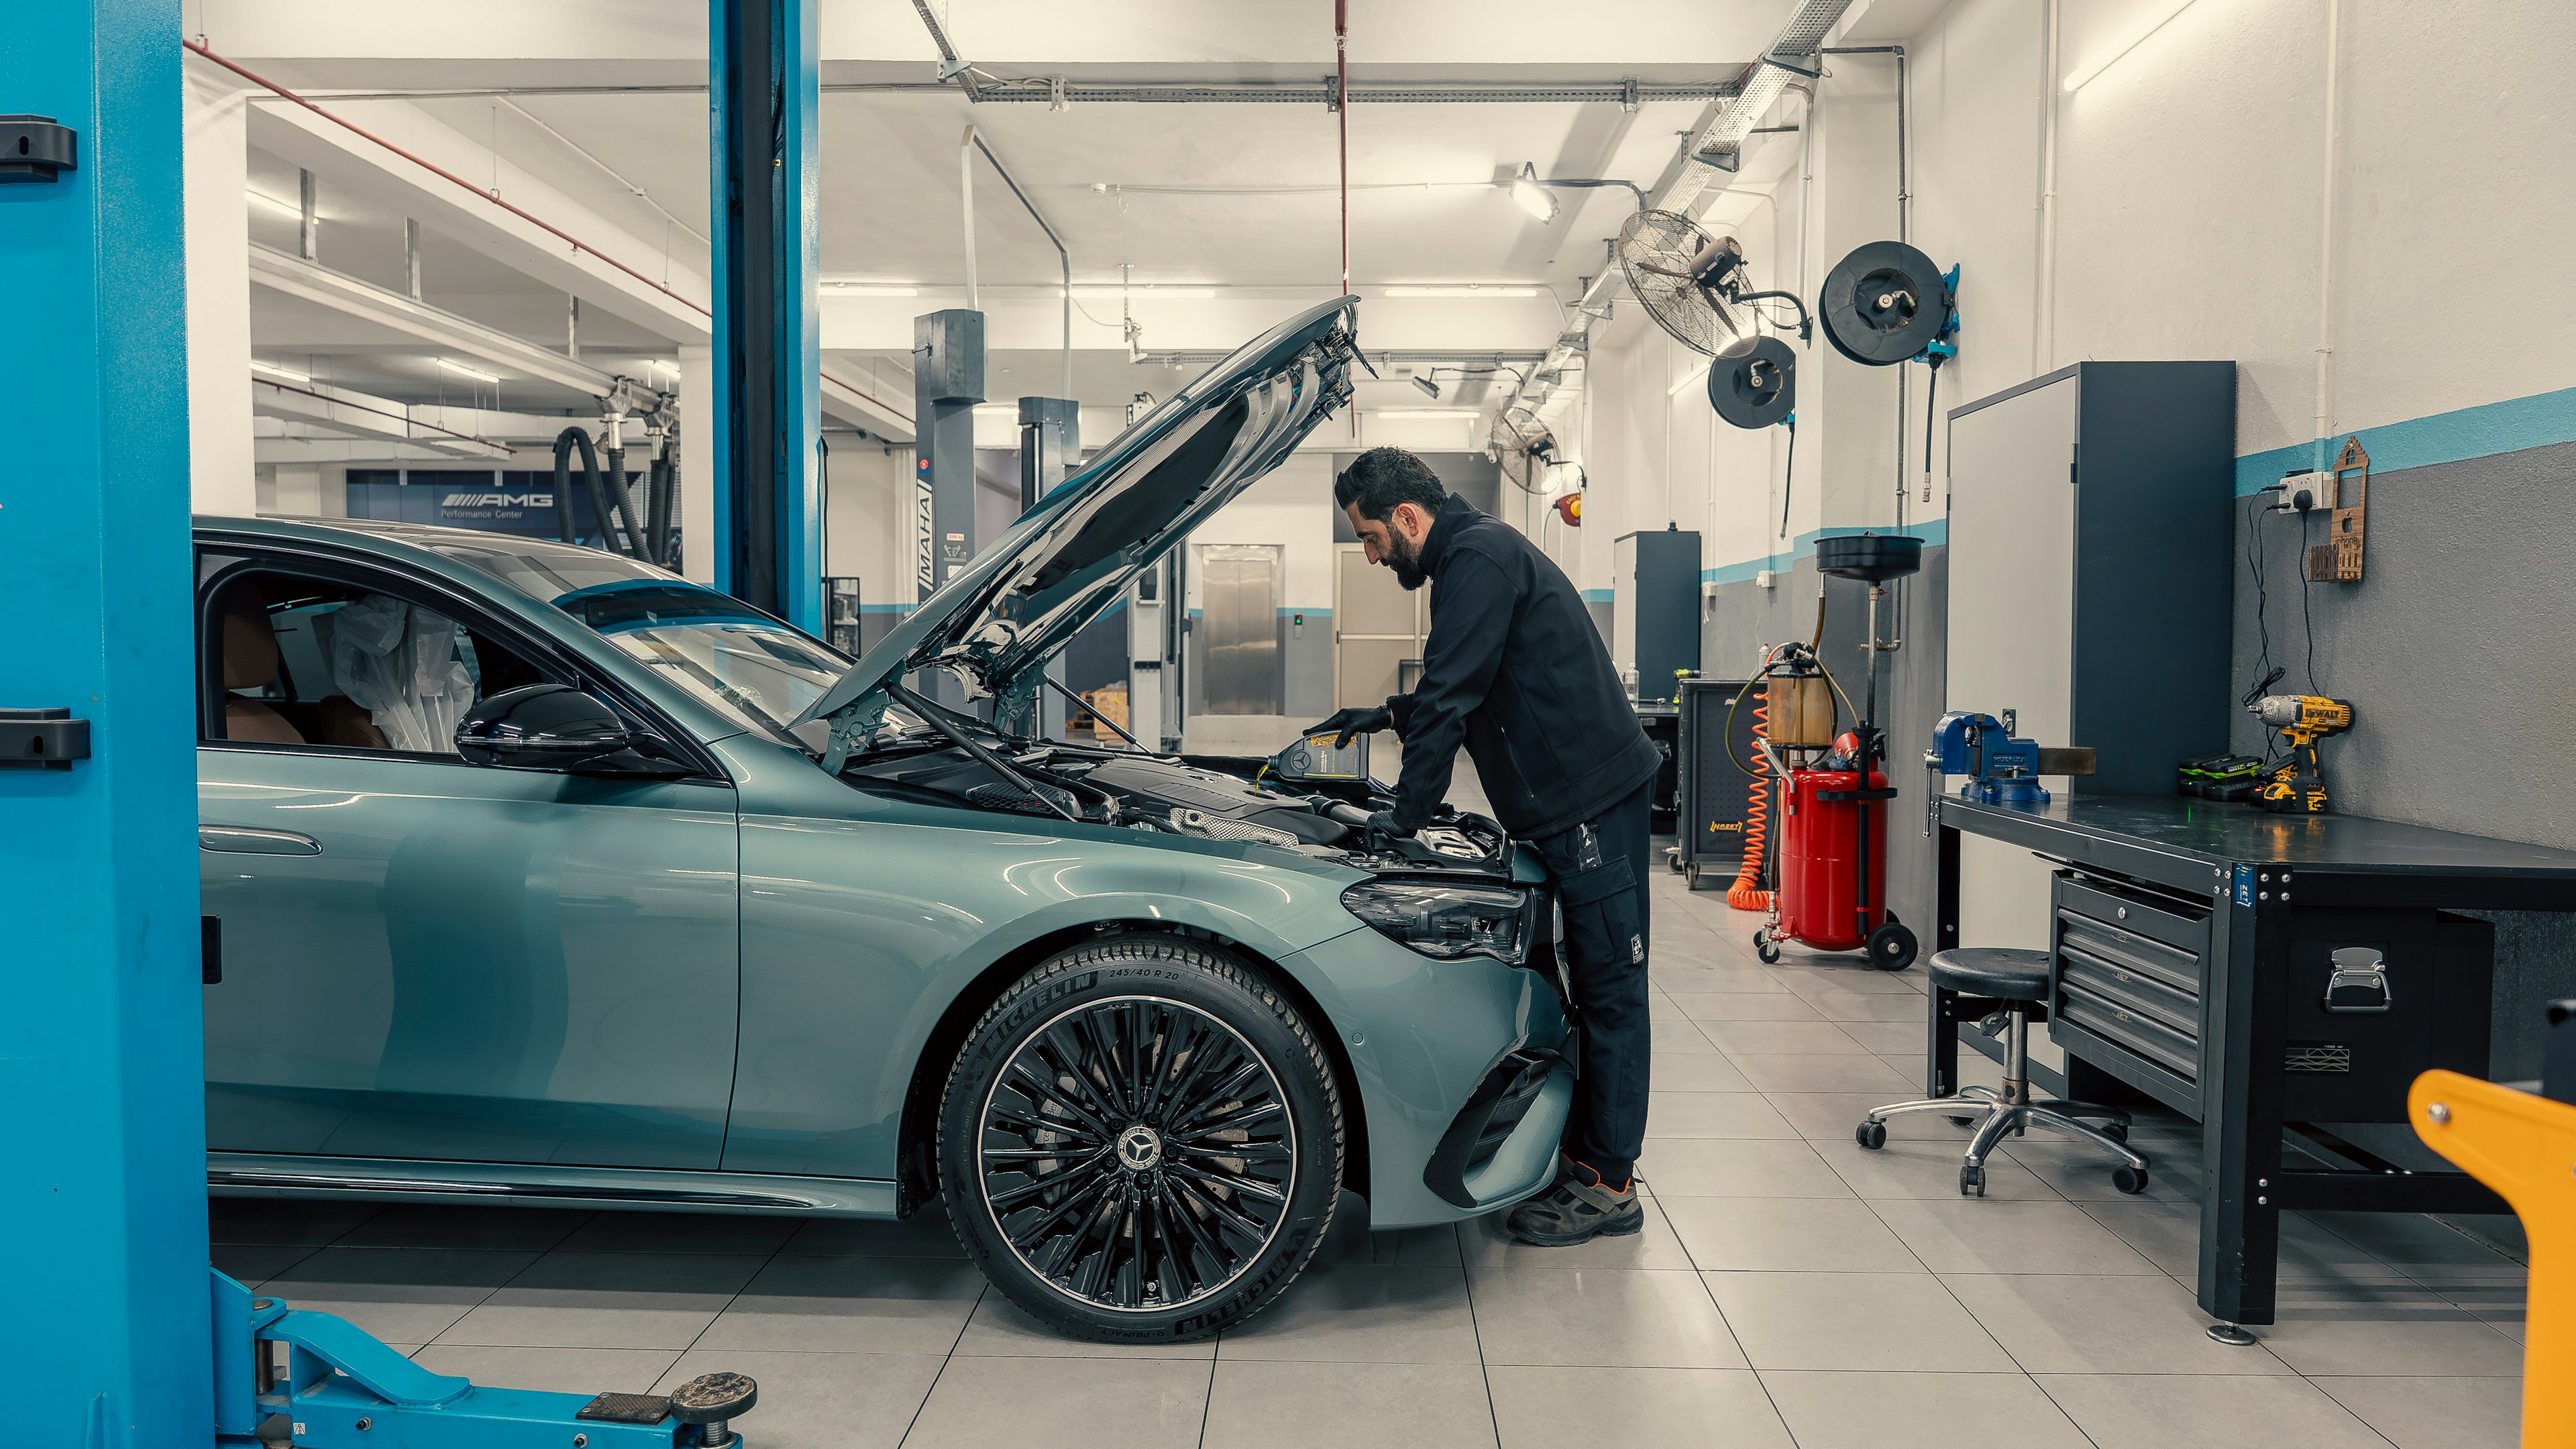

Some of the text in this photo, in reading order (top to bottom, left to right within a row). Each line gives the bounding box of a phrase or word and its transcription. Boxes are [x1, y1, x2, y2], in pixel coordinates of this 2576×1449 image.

[441, 510, 523, 519] Performance Center
[920, 497, 930, 578] MAHA
[1710, 820, 1743, 833] HAZET
[1109, 968, 1179, 981] 245/40 R 20
[984, 973, 1091, 1055] MICHELIN
[1120, 1128, 1140, 1150] MERCEDES
[1145, 1154, 1158, 1167] BENZ
[1183, 1257, 1291, 1334] MICHELIN
